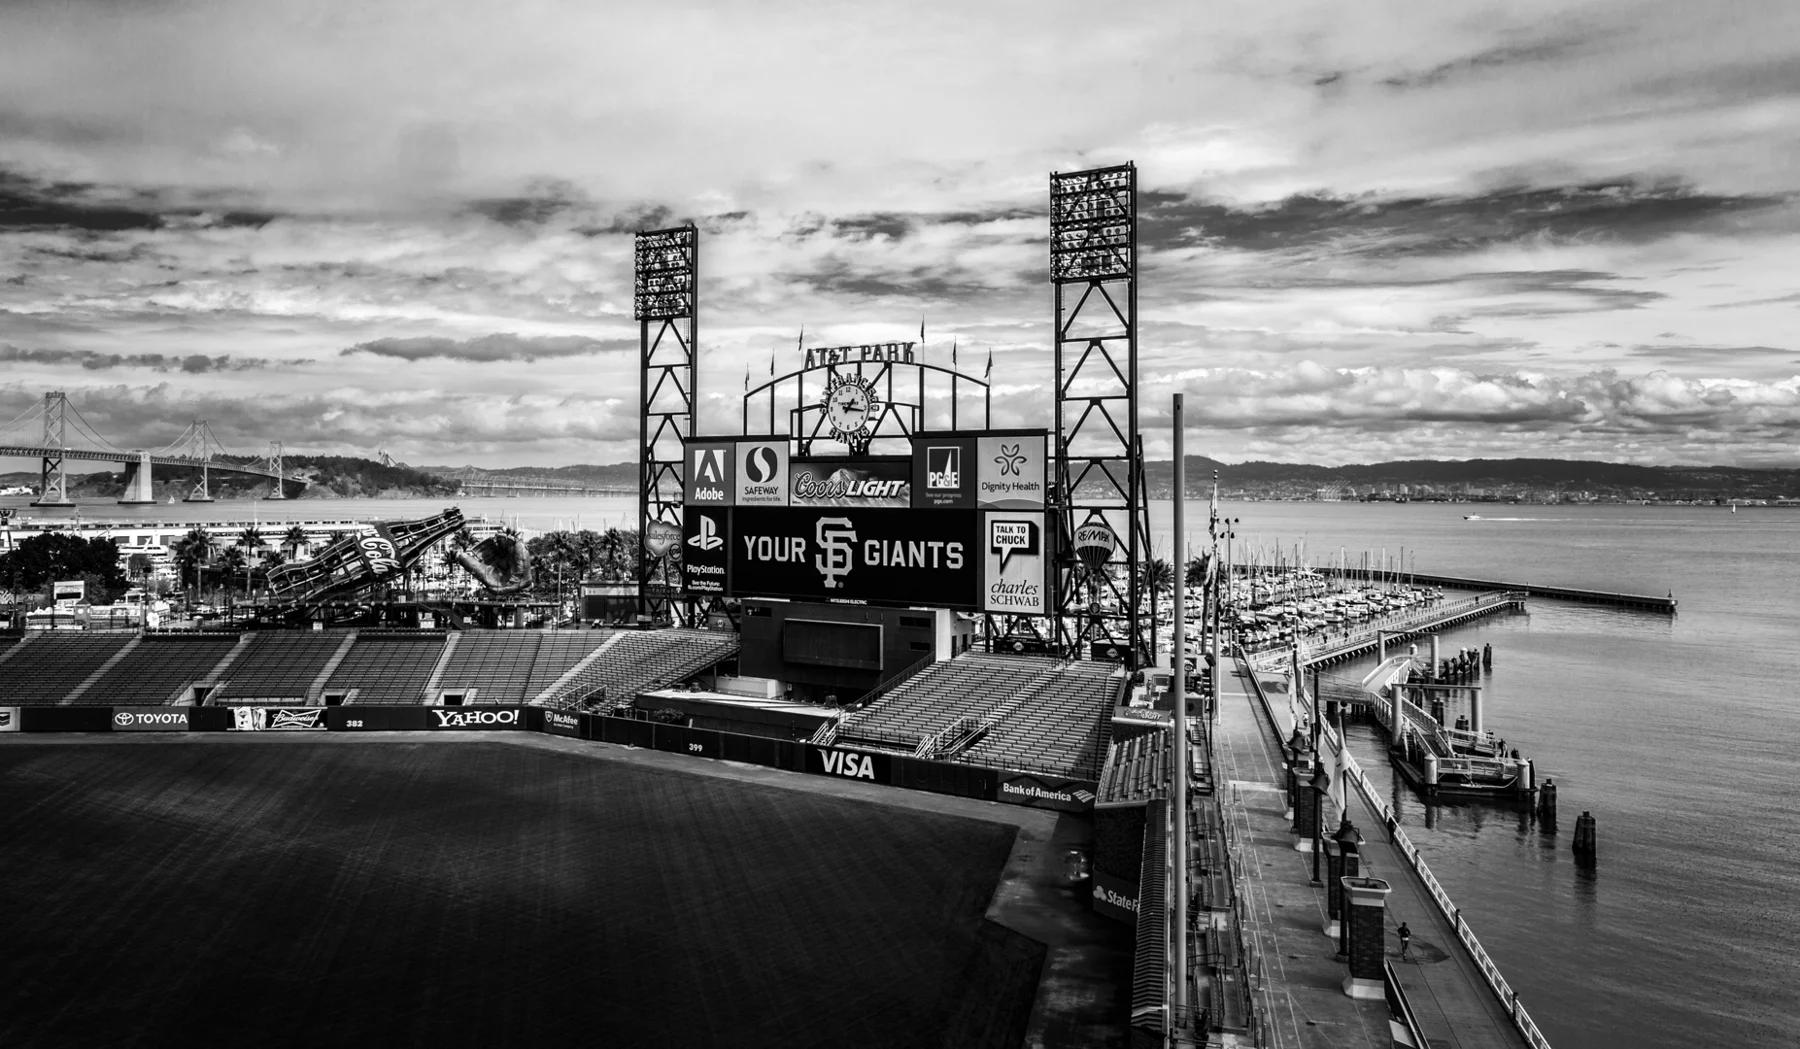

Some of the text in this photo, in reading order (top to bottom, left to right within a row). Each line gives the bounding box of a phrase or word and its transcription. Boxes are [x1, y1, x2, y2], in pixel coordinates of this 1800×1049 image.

[804, 342, 915, 371] AT&T PARK
[830, 373, 880, 412] FRANCSCO
[829, 424, 870, 444] GIANTS
[794, 471, 905, 498] Coors LIGHT
[930, 472, 958, 487] PG&E
[695, 487, 724, 500] Adobe
[744, 486, 779, 495] SAFEWAY
[982, 481, 1040, 493] Dignity Health
[996, 525, 1026, 534] TALK TO
[1078, 528, 1110, 543] RE/MAX
[996, 535, 1026, 545] CHUCK
[743, 535, 964, 569] YOUR GIANTS
[687, 564, 725, 576] PlayStation
[991, 578, 1039, 595] charles
[990, 595, 1039, 606] SCHWAB
[136, 713, 188, 724] TOYOTA
[272, 713, 319, 722] Budweiser
[346, 720, 363, 728] 382
[432, 709, 520, 727] YAHOO!
[553, 713, 578, 725] McAfee
[689, 743, 703, 752] 399
[817, 748, 875, 780] VISA
[1003, 782, 1072, 801] Bank of America
